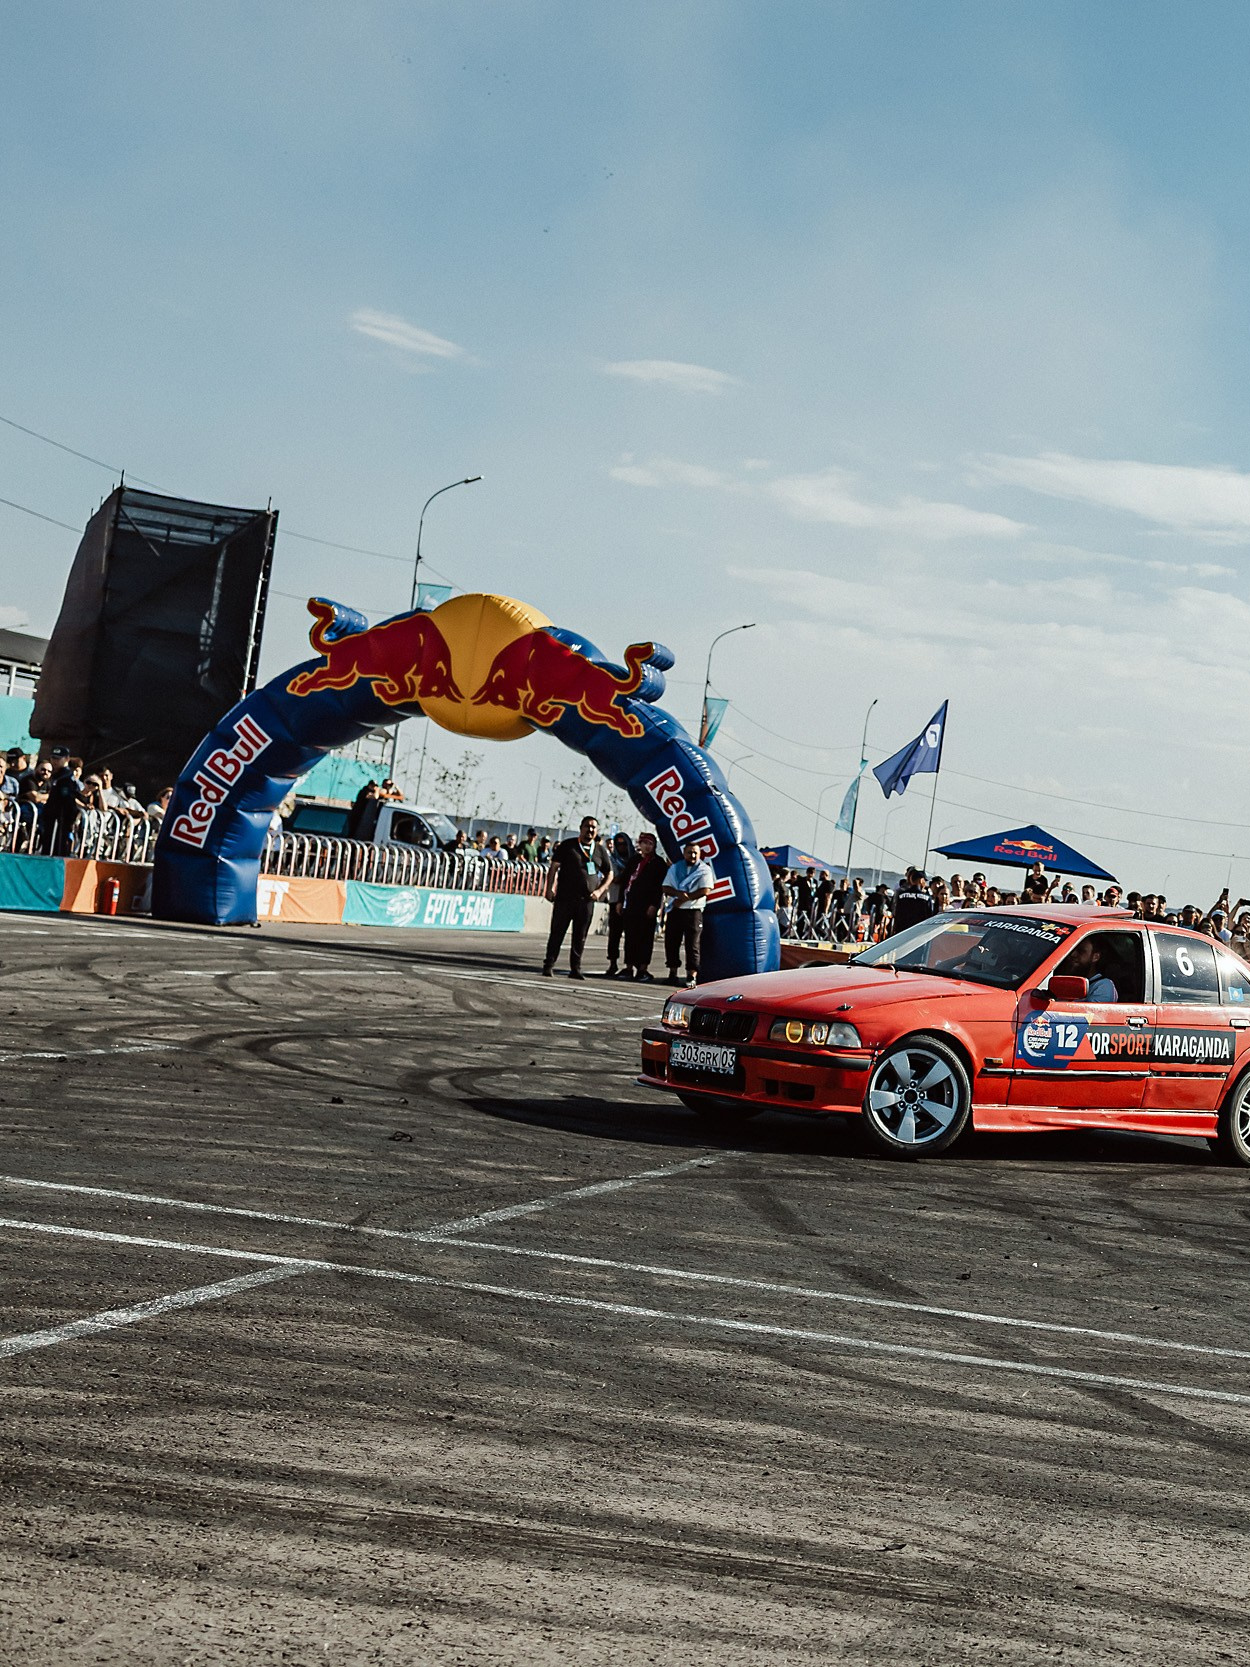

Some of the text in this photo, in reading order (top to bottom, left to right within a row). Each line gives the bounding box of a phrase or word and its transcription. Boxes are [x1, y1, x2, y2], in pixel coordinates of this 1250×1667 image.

[170, 714, 272, 849] Red Bull
[645, 765, 736, 904] Red Bll
[994, 845, 1057, 861] Red Bull
[984, 920, 1061, 944] KARAGANDA
[1175, 947, 1195, 977] 6
[1056, 1024, 1079, 1048] 12
[1154, 1034, 1230, 1059] KARAGANDA
[721, 1051, 735, 1068] 03
